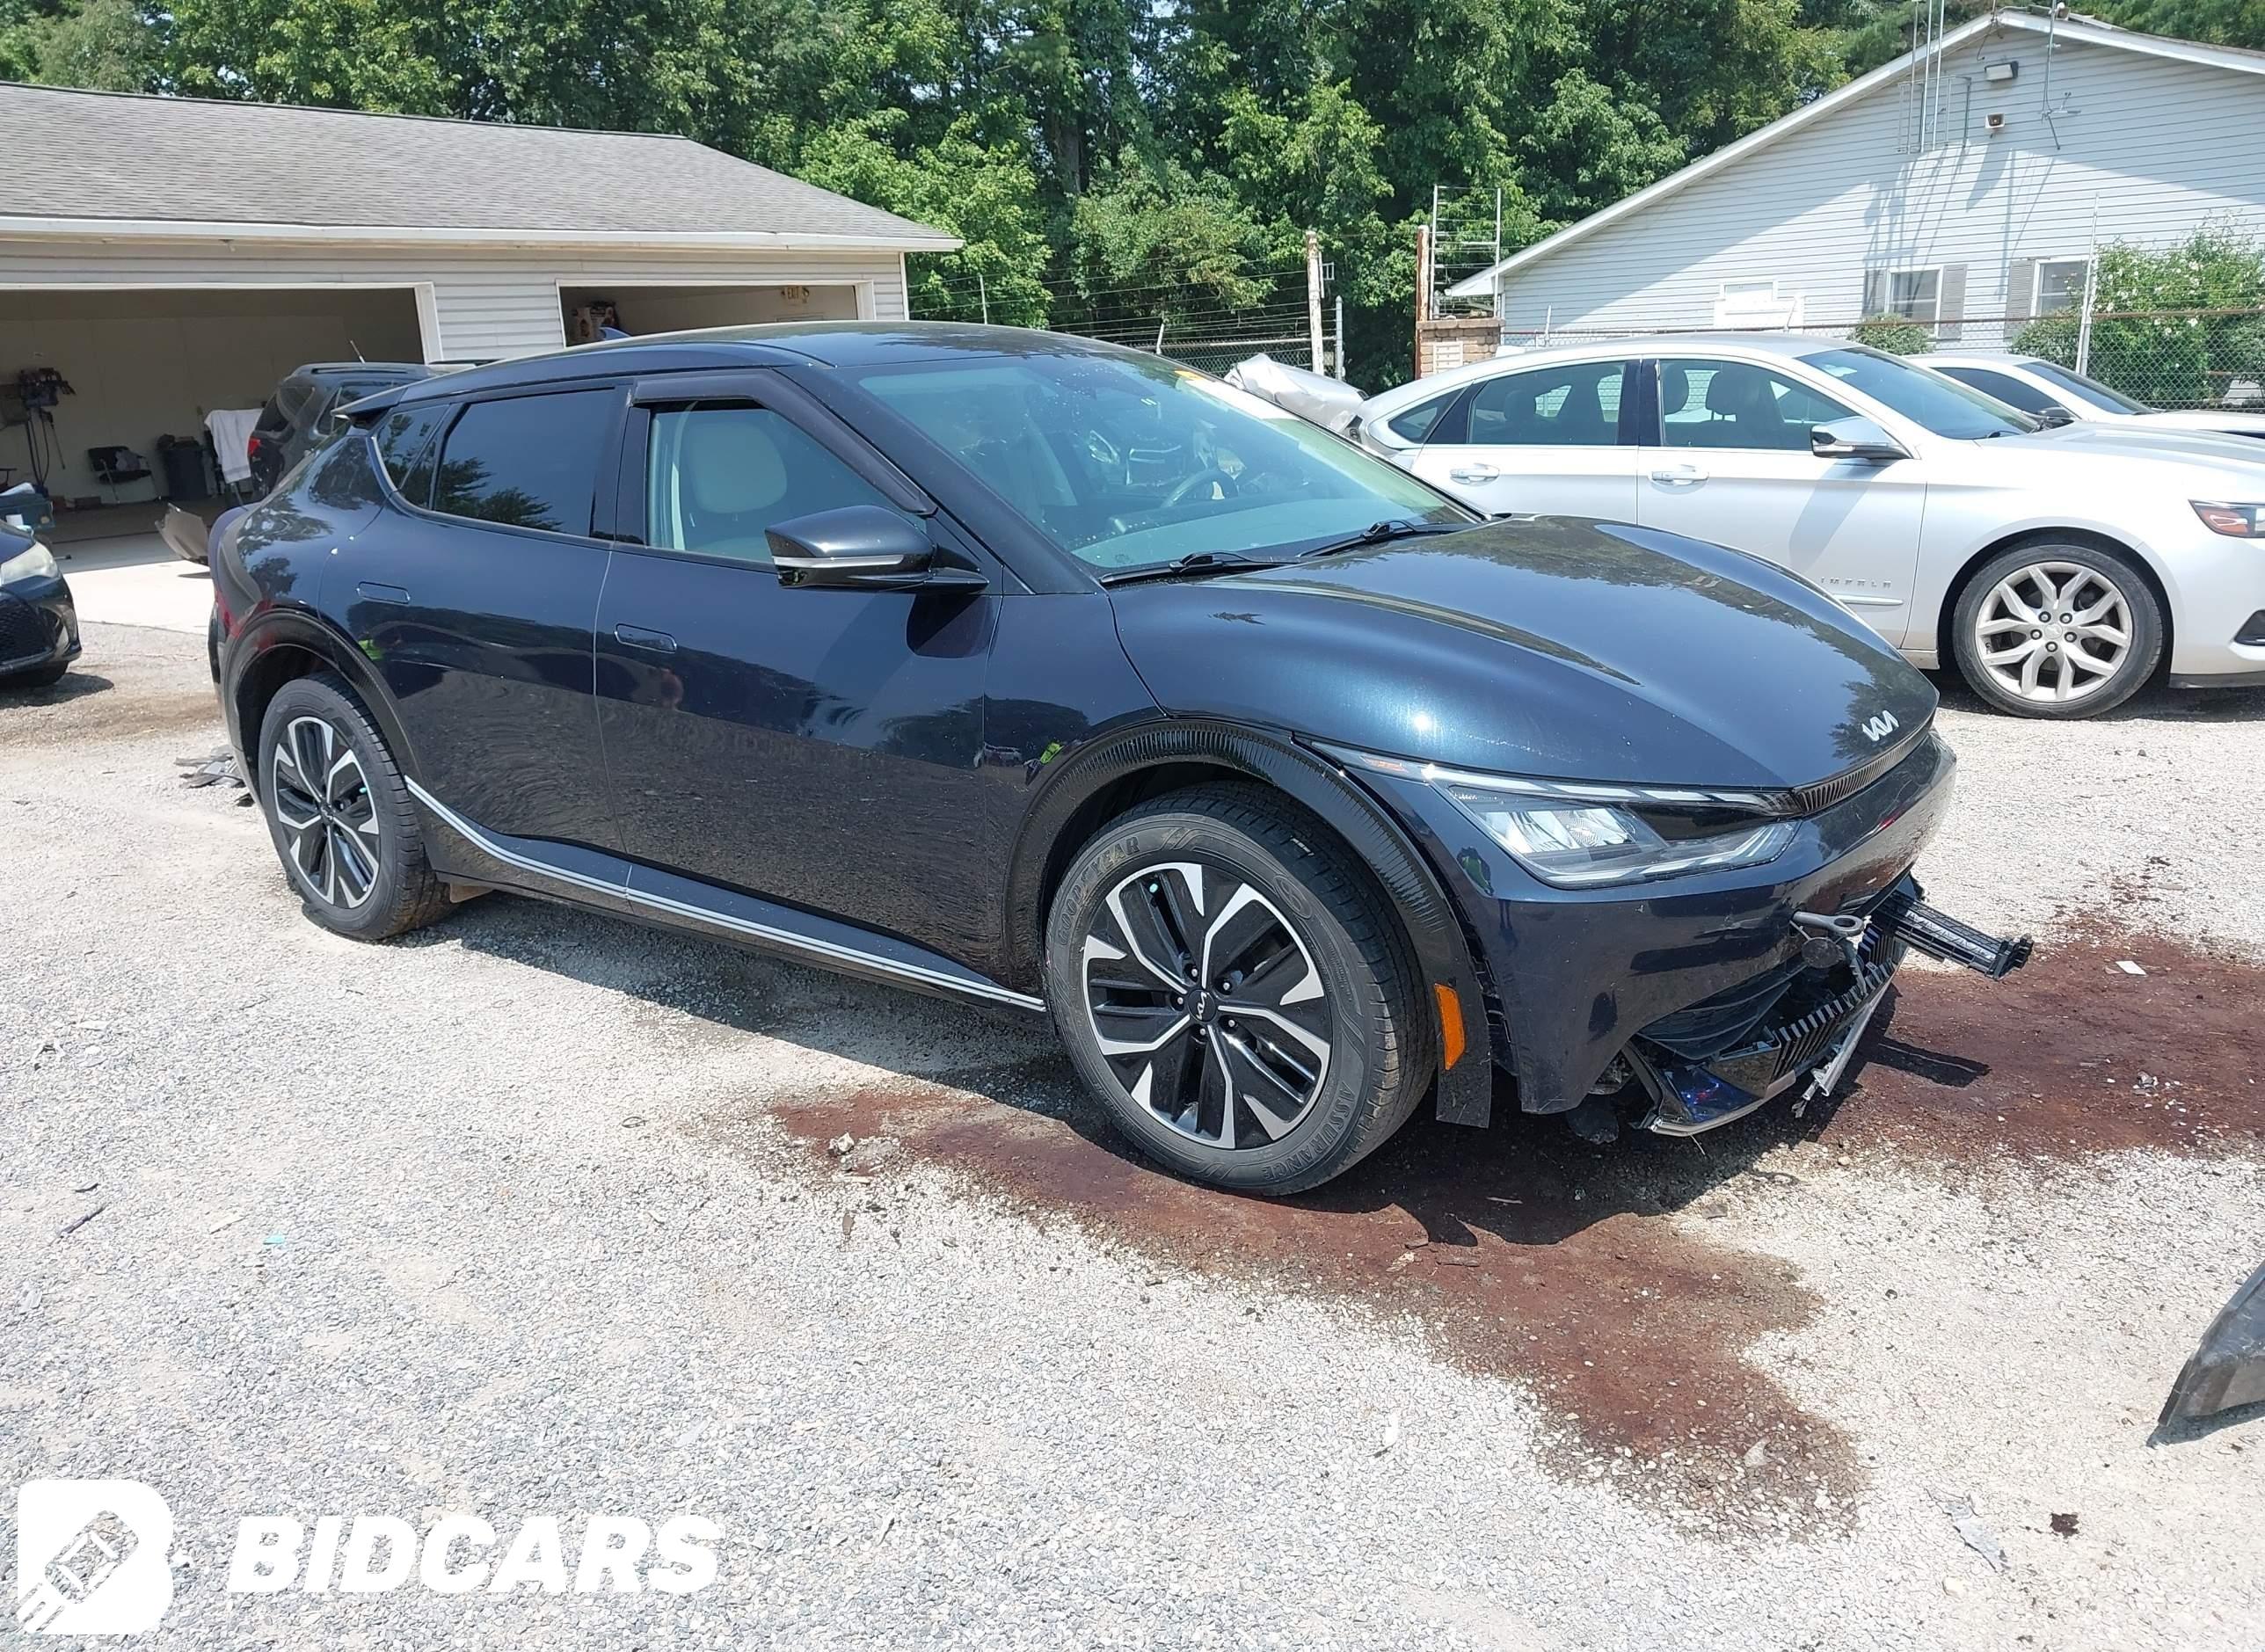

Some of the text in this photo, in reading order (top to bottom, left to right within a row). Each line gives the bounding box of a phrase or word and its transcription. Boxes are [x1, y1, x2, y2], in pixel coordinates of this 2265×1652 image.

[1820, 577, 1891, 589] IMPALA
[1861, 710, 1899, 741] KIA
[1262, 1081, 1355, 1183] ASSURANCE
